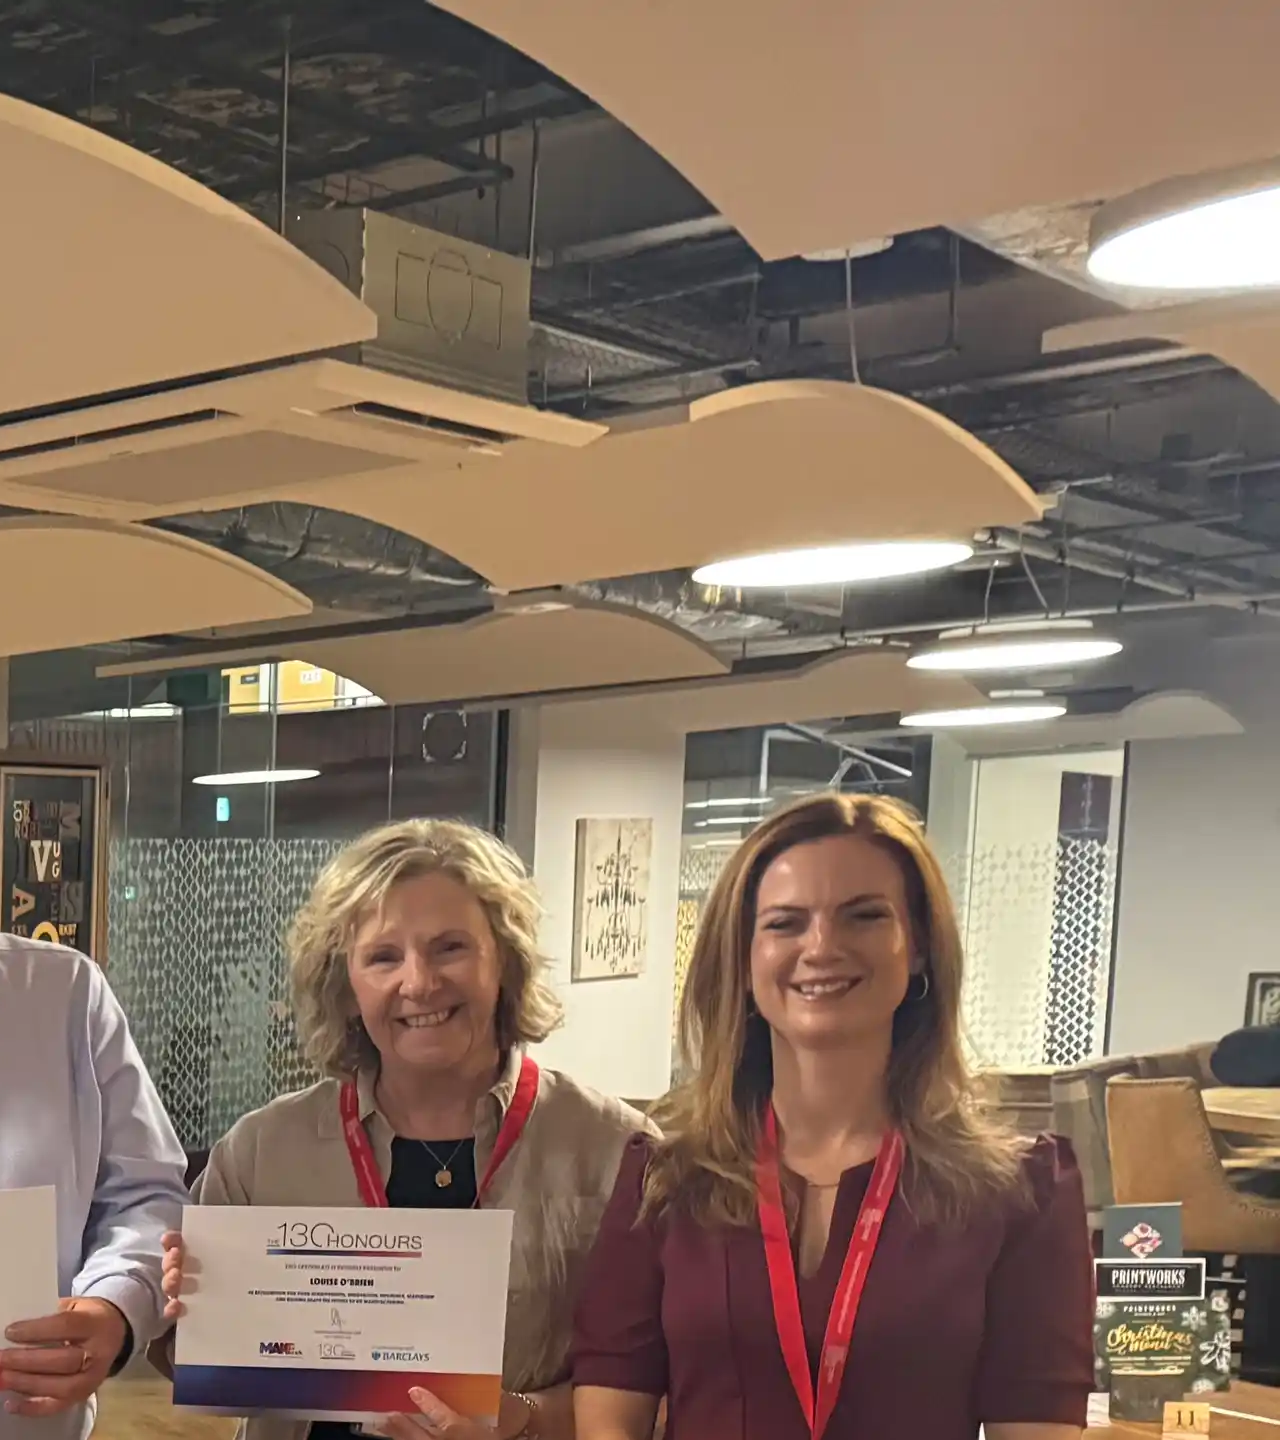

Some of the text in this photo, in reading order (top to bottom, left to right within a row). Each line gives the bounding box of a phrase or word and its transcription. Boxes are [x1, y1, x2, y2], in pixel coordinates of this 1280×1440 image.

[327, 1234, 423, 1250] HONOURS
[310, 1277, 339, 1286] LOUISE
[1111, 1269, 1186, 1285] PRINTWORKS
[382, 1351, 430, 1362] BARCLAYS
